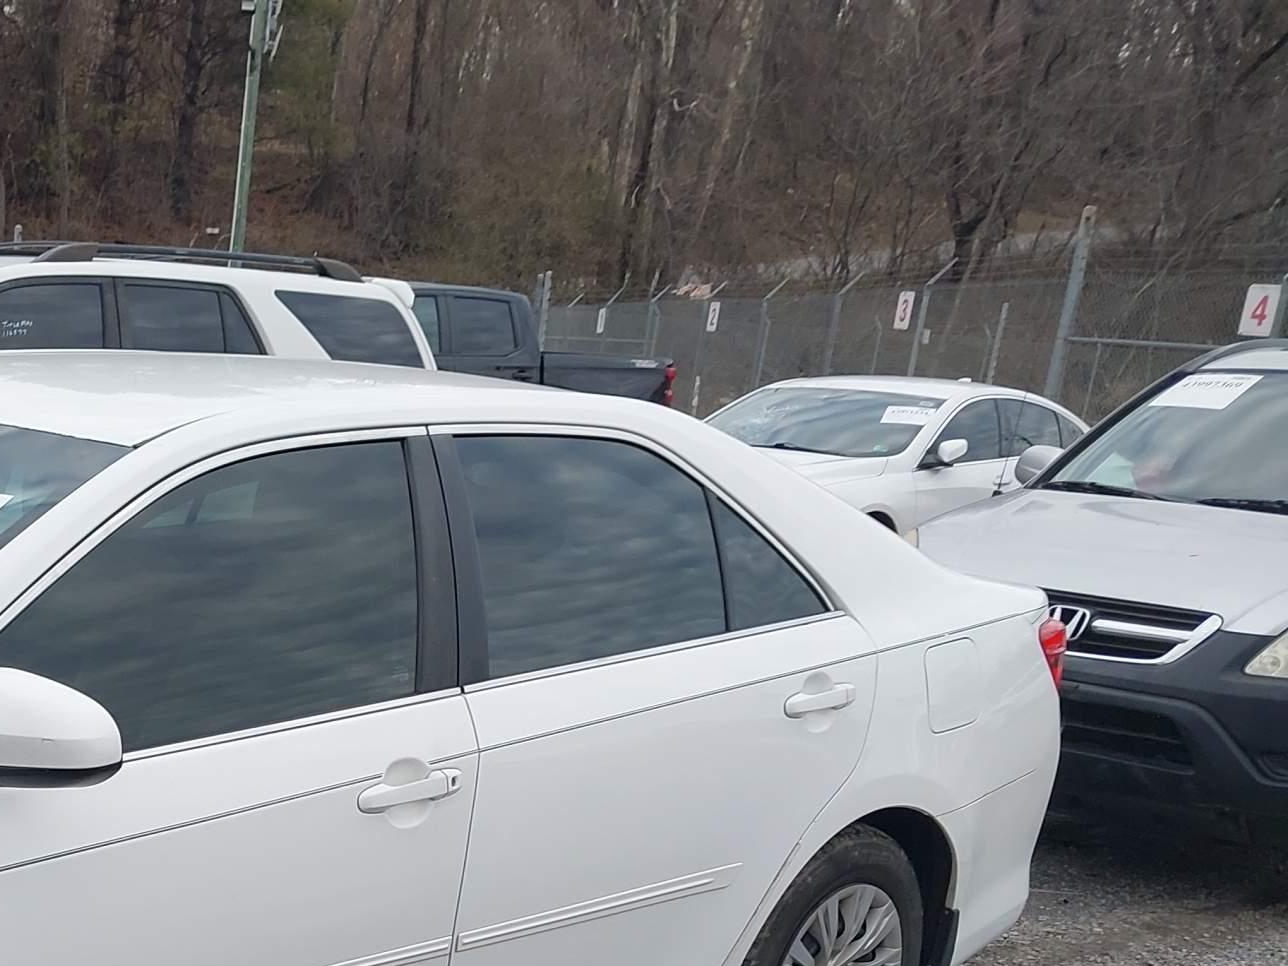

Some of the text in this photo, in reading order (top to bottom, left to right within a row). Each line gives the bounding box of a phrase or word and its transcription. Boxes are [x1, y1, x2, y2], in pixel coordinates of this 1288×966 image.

[708, 307, 718, 326] 2
[898, 298, 910, 322] 3
[1249, 294, 1270, 327] 4
